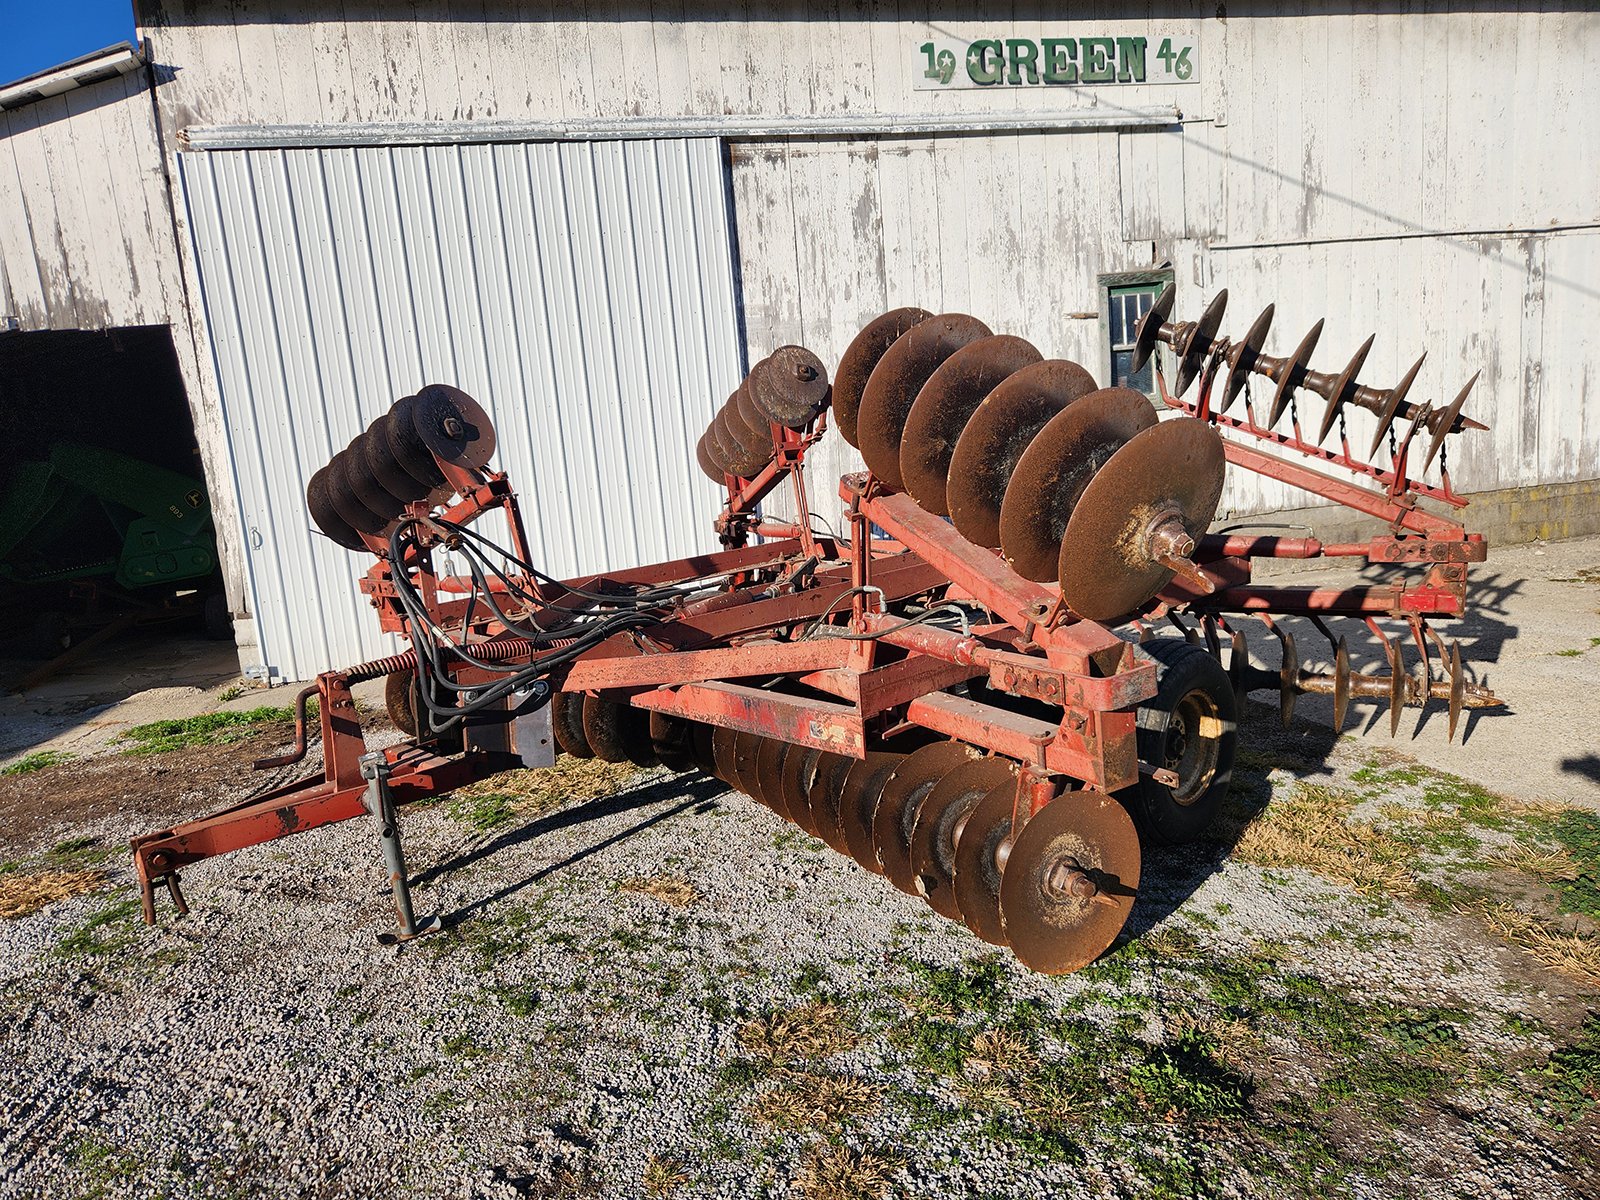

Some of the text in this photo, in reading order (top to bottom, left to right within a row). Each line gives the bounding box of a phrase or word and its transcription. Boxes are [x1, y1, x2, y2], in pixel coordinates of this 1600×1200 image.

[920, 37, 1192, 85] 19 GREEN 46
